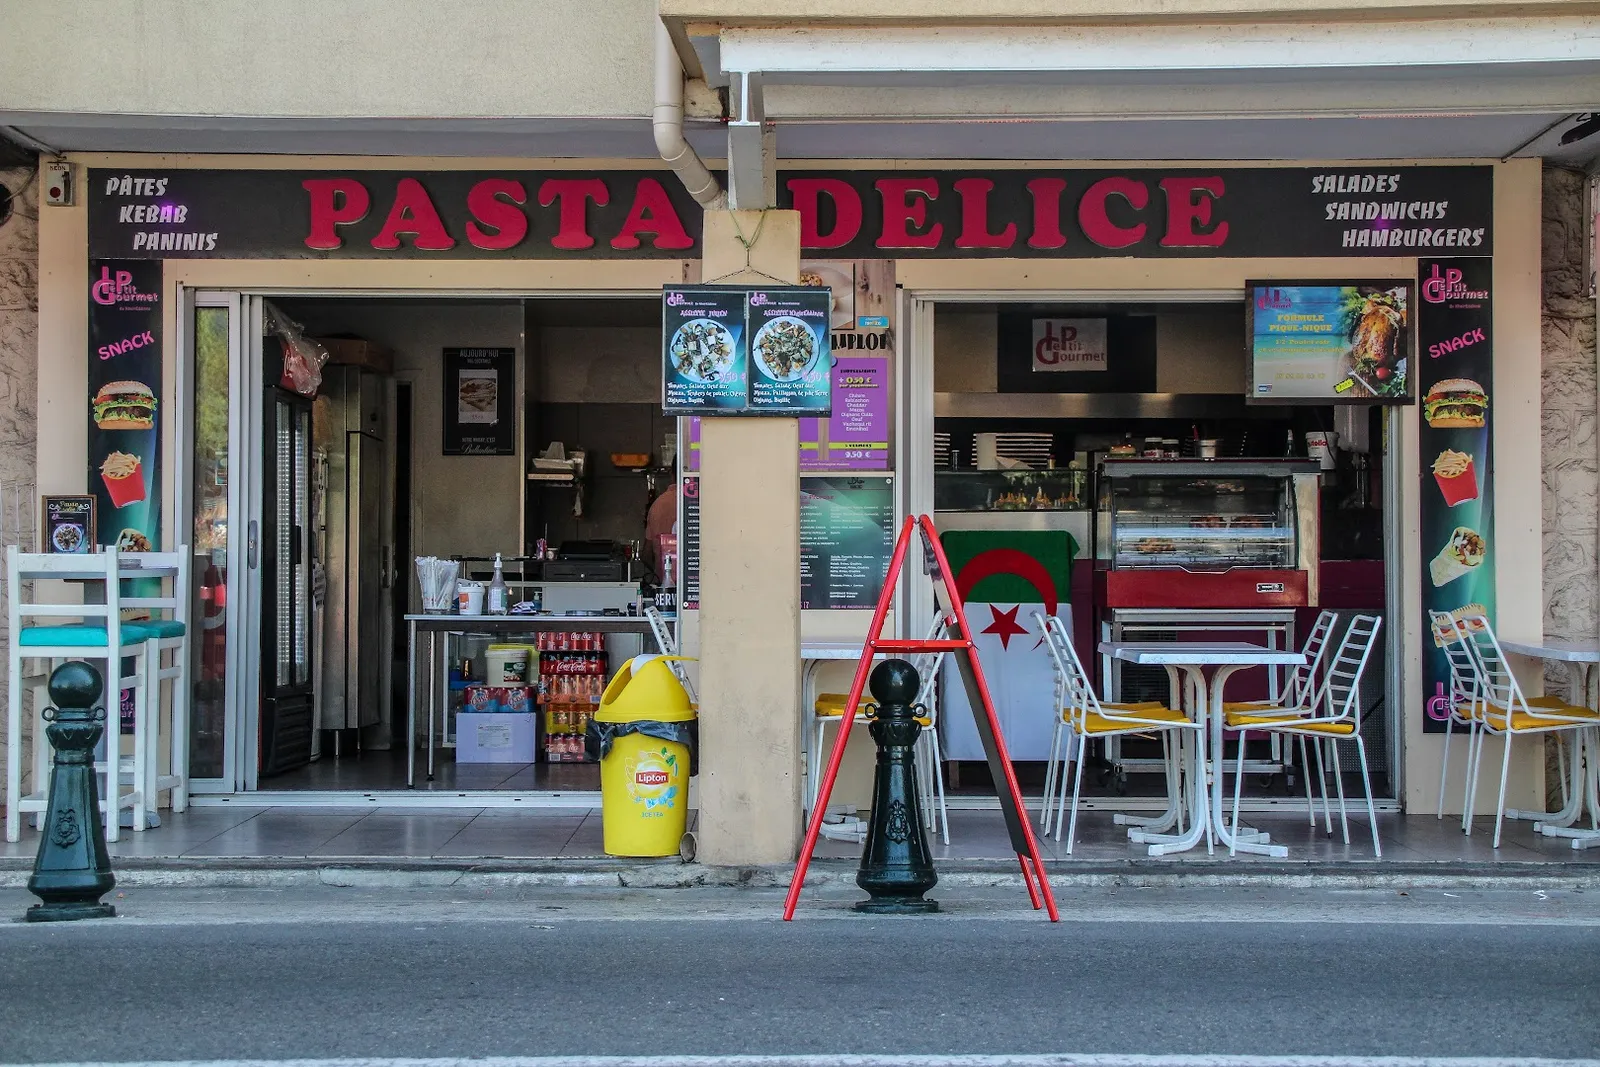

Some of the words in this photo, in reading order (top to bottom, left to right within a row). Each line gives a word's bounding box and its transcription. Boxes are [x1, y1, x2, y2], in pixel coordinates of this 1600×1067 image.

[106, 174, 168, 196] PÂTES
[1311, 174, 1400, 194] SALADES
[119, 205, 188, 223] KEBAB
[302, 178, 694, 250] PASTA
[787, 176, 1229, 249] DELICE
[1325, 201, 1448, 221] SANDWICHS
[133, 232, 218, 251] PANINIS
[1342, 227, 1485, 248] HAMBURGERS
[92, 279, 158, 305] Gourmet
[1422, 277, 1488, 303] Gourmet
[1277, 314, 1325, 322] FORMULE
[1269, 324, 1333, 333] PIQUE-NIQUE
[98, 331, 155, 360] SNACK
[1036, 337, 1105, 364] Gourmet
[1429, 328, 1486, 358] SNACK
[460, 349, 499, 358] AUJOURD'HUI
[638, 774, 666, 783] Lipton
